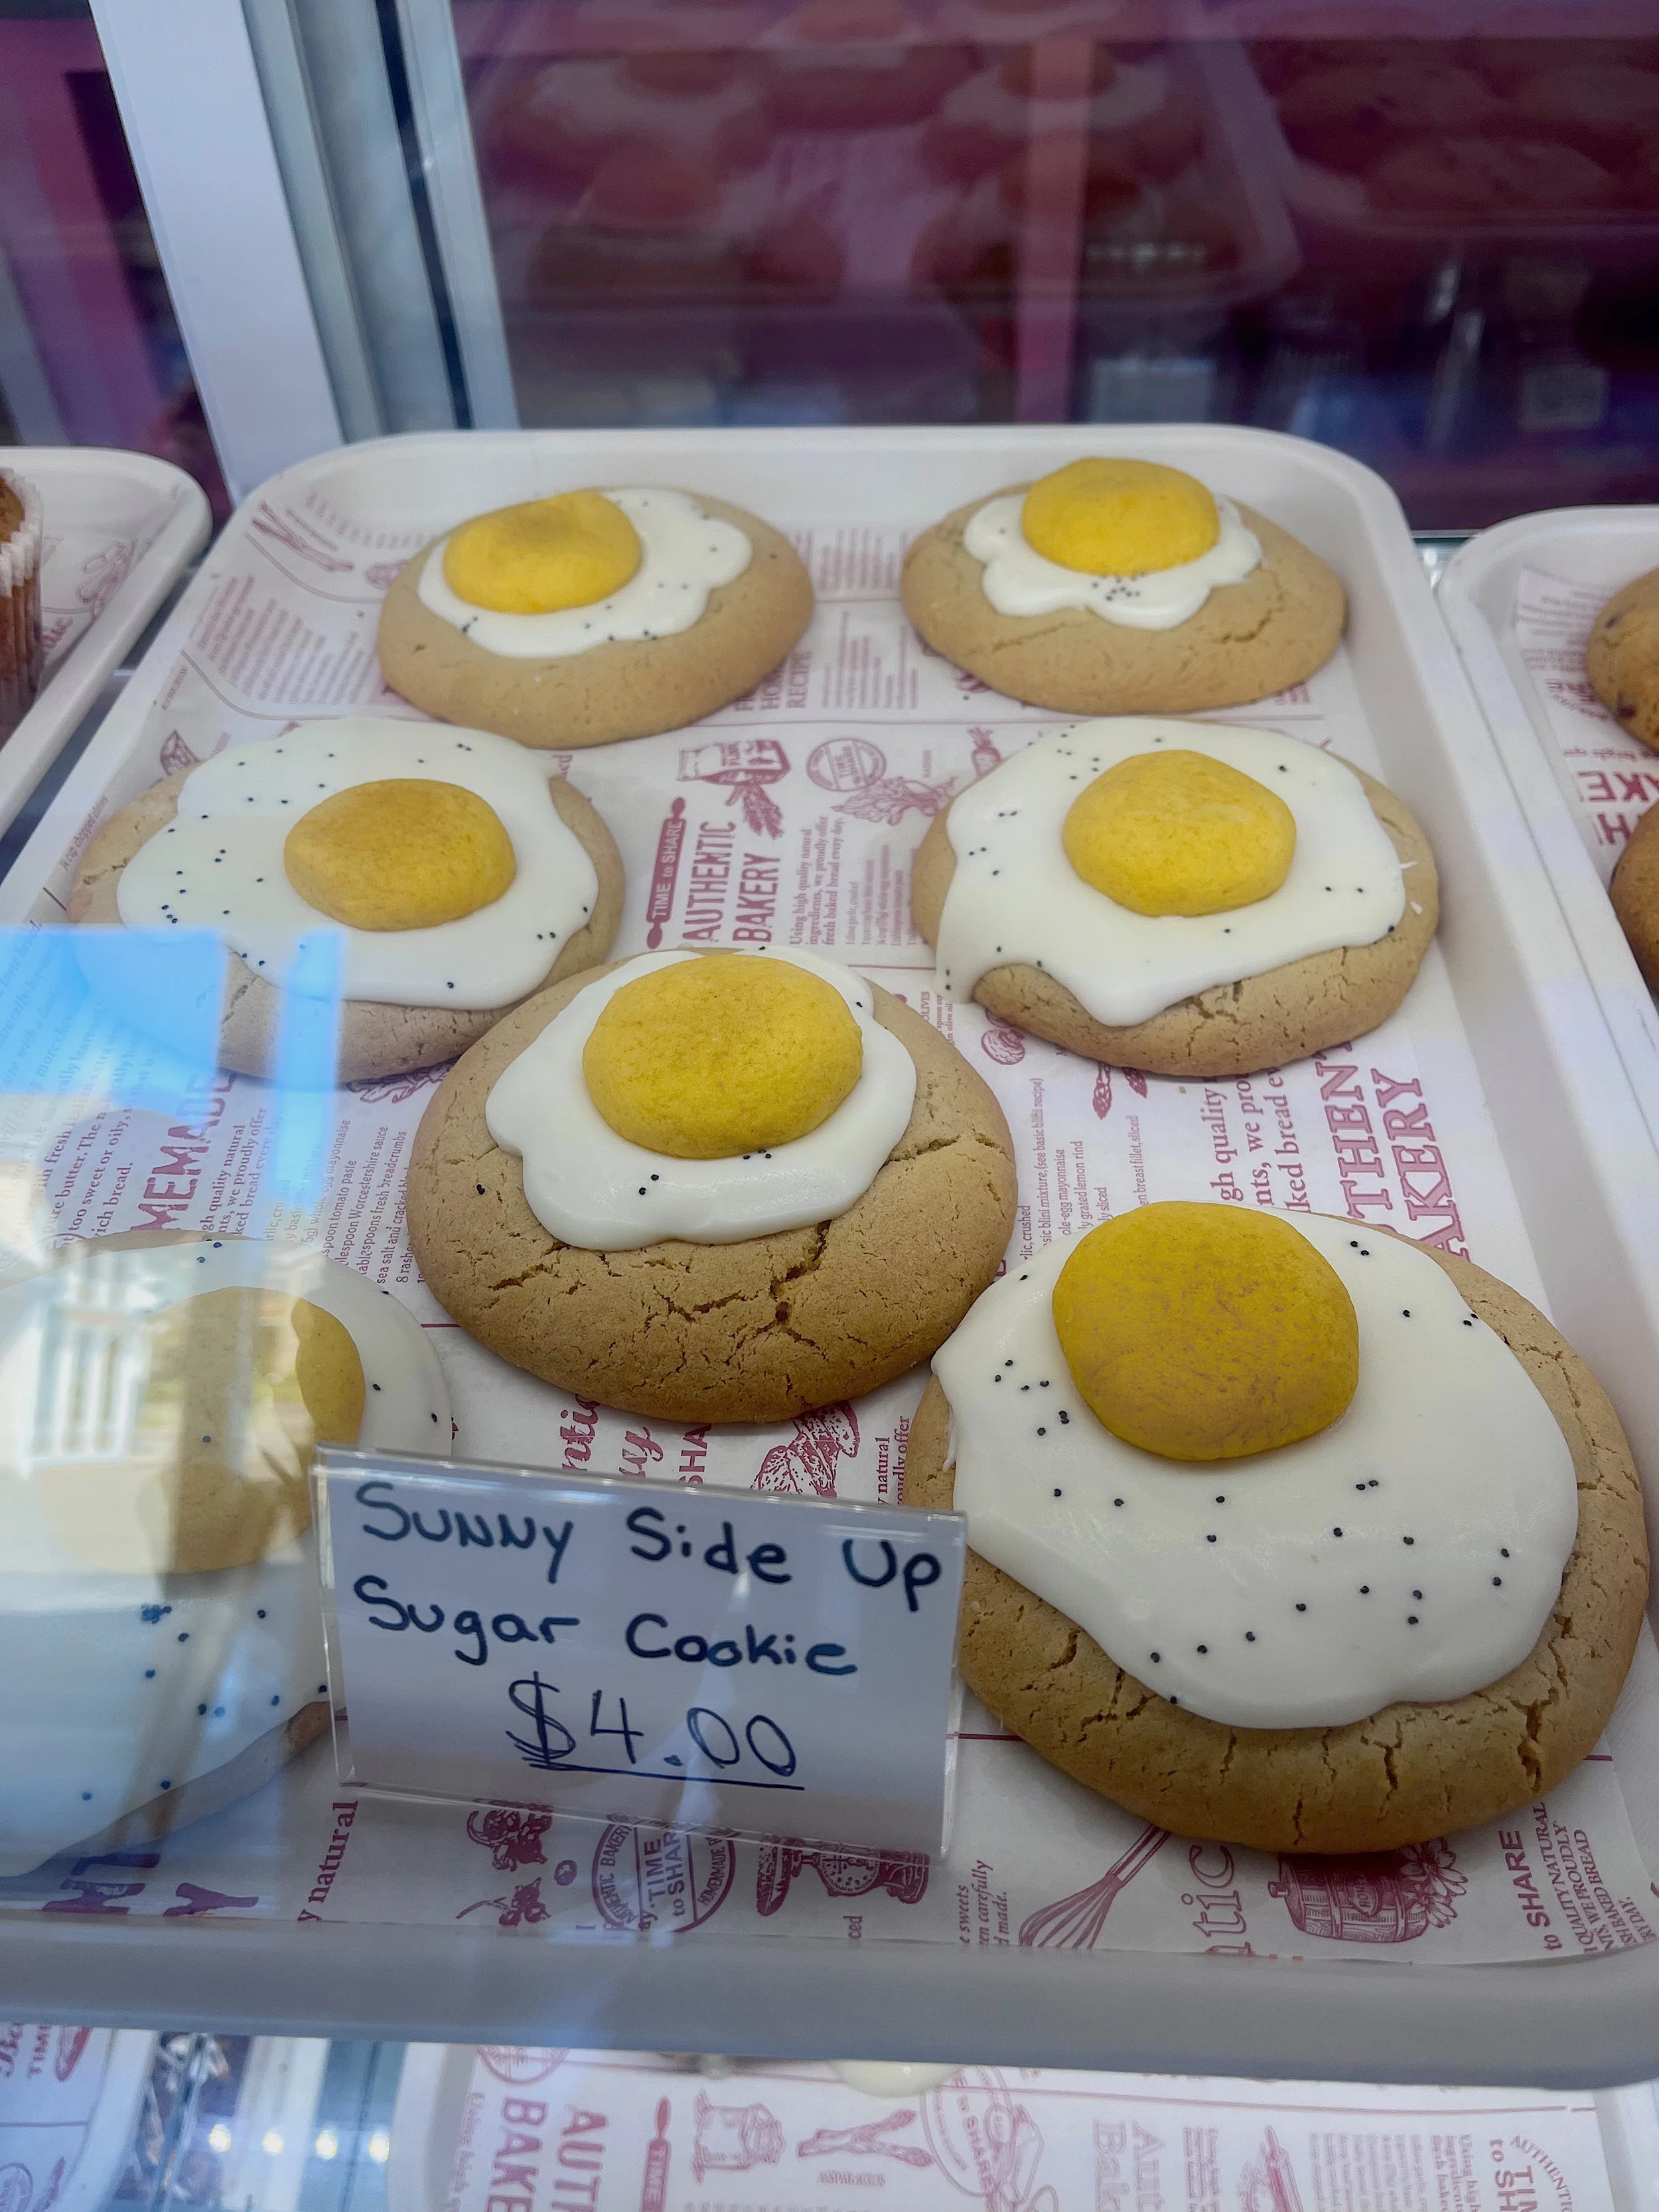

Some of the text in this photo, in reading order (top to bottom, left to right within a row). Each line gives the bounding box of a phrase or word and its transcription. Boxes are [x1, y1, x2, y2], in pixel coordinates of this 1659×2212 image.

[651, 822, 683, 920] TIME to SHARE
[826, 861, 839, 887] bread
[832, 837, 845, 860] every
[682, 821, 736, 942] AUTHENTIC
[732, 853, 780, 942] BAKERY
[790, 828, 812, 945] Using high quality natural
[806, 815, 829, 945] ingredients, we proudly offer
[824, 891, 838, 919] baked
[822, 921, 835, 946] fresh
[1029, 1077, 1045, 1106] recipe)
[1031, 1105, 1044, 1129] blini
[44, 1130, 72, 1166] fresh
[325, 1119, 351, 1175] mayonnaise
[1033, 1129, 1046, 1151] basic
[1070, 1140, 1084, 1161] rind
[1125, 1114, 1141, 1142] sliced
[1200, 1087, 1238, 1164] quality
[1246, 1121, 1264, 1153] we
[1263, 1094, 1300, 1157] bread
[55, 1151, 90, 1199] butter.
[76, 1122, 101, 1152] The
[102, 1162, 134, 1207] bread.
[209, 1169, 231, 1213] quality
[223, 1124, 246, 1168] natural
[228, 1188, 240, 1207] we
[234, 1138, 258, 1187] proudly
[250, 1107, 267, 1137] offer
[240, 1171, 261, 1209] bread
[255, 1138, 272, 1169] every
[350, 1151, 380, 1223] Worcestershire
[373, 1126, 389, 1151] sauce
[379, 1130, 407, 1189] breadcrumbs
[1055, 1149, 1070, 1201] mayonnaise
[1072, 1164, 1087, 1191] lemon
[1133, 1163, 1147, 1194] breast
[68, 1207, 88, 1233] too
[82, 1166, 106, 1207] sweet
[100, 1149, 114, 1165] or
[330, 1187, 349, 1224] tomato
[341, 1159, 357, 1185] paste
[375, 1187, 390, 1214] fresh
[1074, 1191, 1092, 1220] grated
[1093, 1187, 1110, 1212] sliced
[386, 1226, 401, 1245] and
[1017, 1205, 1033, 1242] crushed
[1037, 1211, 1051, 1234] blini
[376, 1266, 390, 1284] sea
[380, 1244, 396, 1265] salt
[895, 1416, 911, 1455] offer
[875, 1437, 891, 1495] natural
[626, 1505, 792, 1585] Side
[841, 1536, 942, 1613] Up
[352, 1574, 858, 1676] Sugar Cookie
[504, 1670, 798, 1777] $4.00
[307, 1800, 359, 1903] natural
[643, 1838, 666, 1900] TIME
[1532, 1801, 1565, 1885] NATURAL
[1553, 1820, 1591, 1901] PROUDLY
[697, 1846, 727, 1907] HOMEMADE
[972, 1859, 993, 1923] carefully
[1498, 1830, 1563, 1951] to SHARE
[1573, 1829, 1628, 1929] BAKED BREAD
[672, 1899, 685, 1917] to
[956, 1884, 970, 1933] sweets
[991, 1891, 1009, 1935] made.
[1554, 1886, 1593, 1945] QUALITY
[1581, 1901, 1601, 1925] WE
